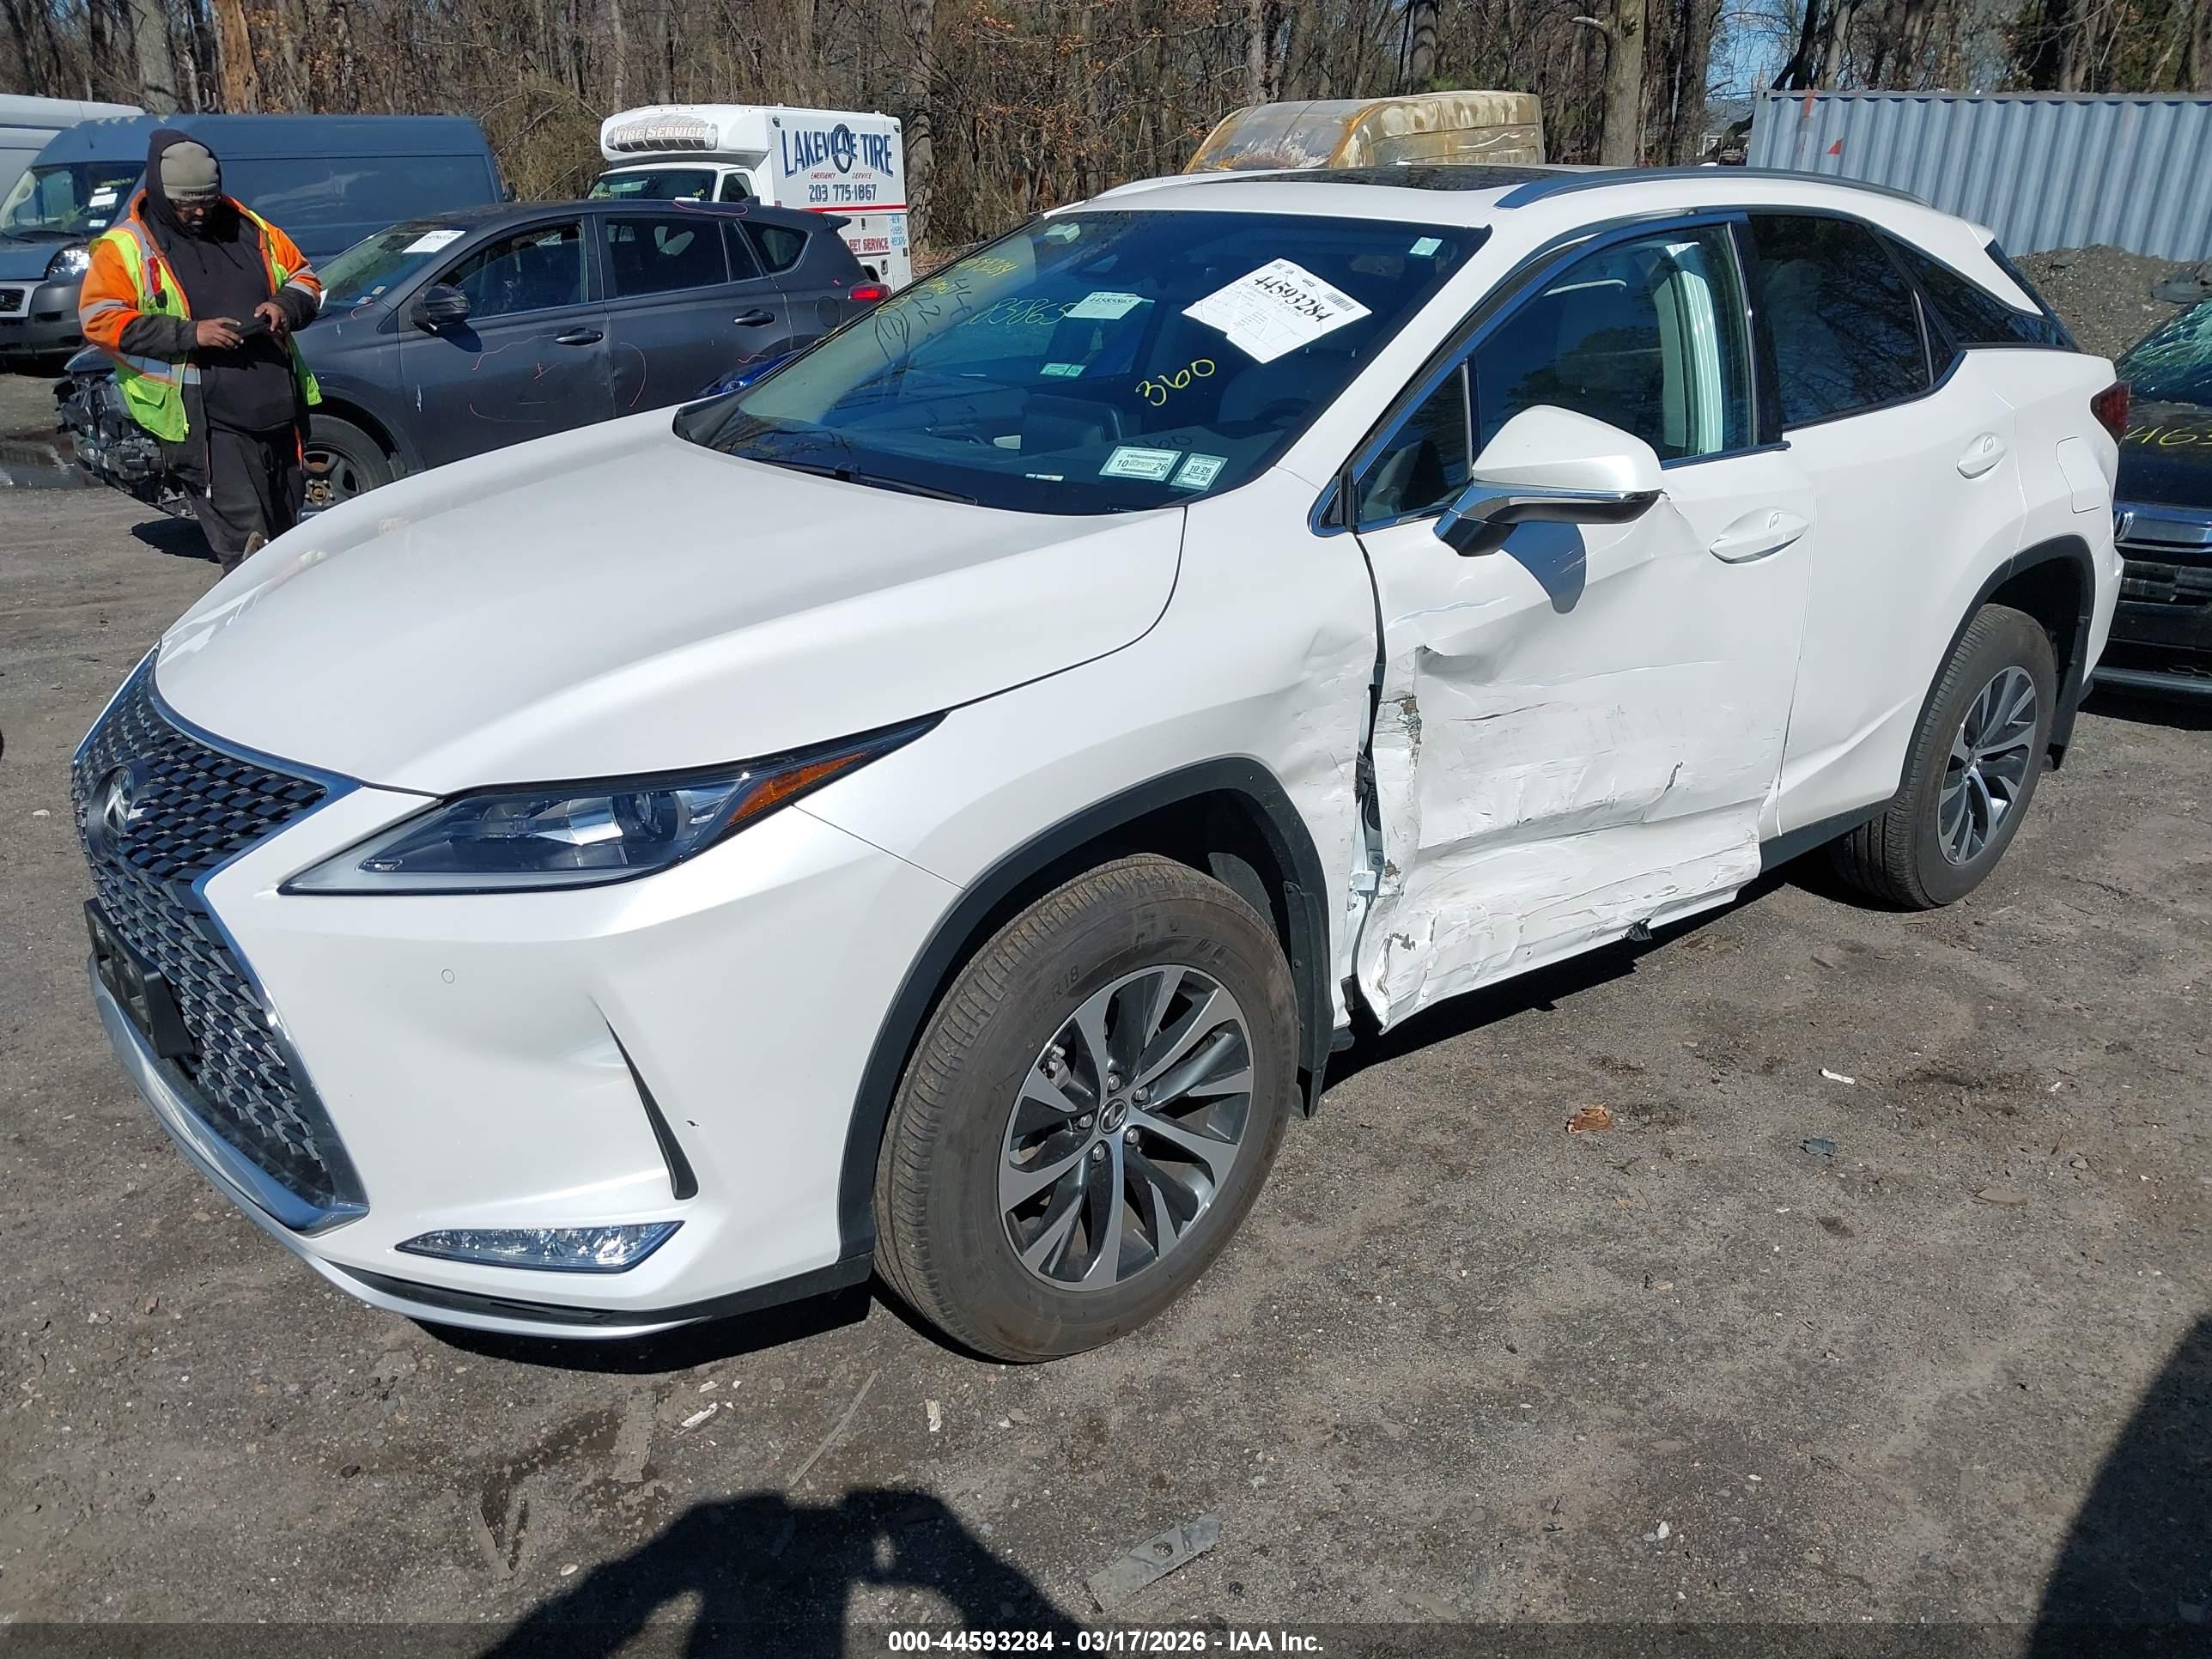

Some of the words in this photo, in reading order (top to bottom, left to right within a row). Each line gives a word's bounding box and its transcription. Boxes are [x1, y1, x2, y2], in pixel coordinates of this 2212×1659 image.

[646, 124, 706, 140] SERVICE
[860, 133, 894, 178] TIRE
[808, 184, 829, 202] 203
[863, 237, 890, 252] SERVICE
[1254, 275, 1335, 323] 44593284
[1135, 359, 1215, 406] 360
[1117, 459, 1129, 468] 10
[1153, 463, 1169, 471] 26
